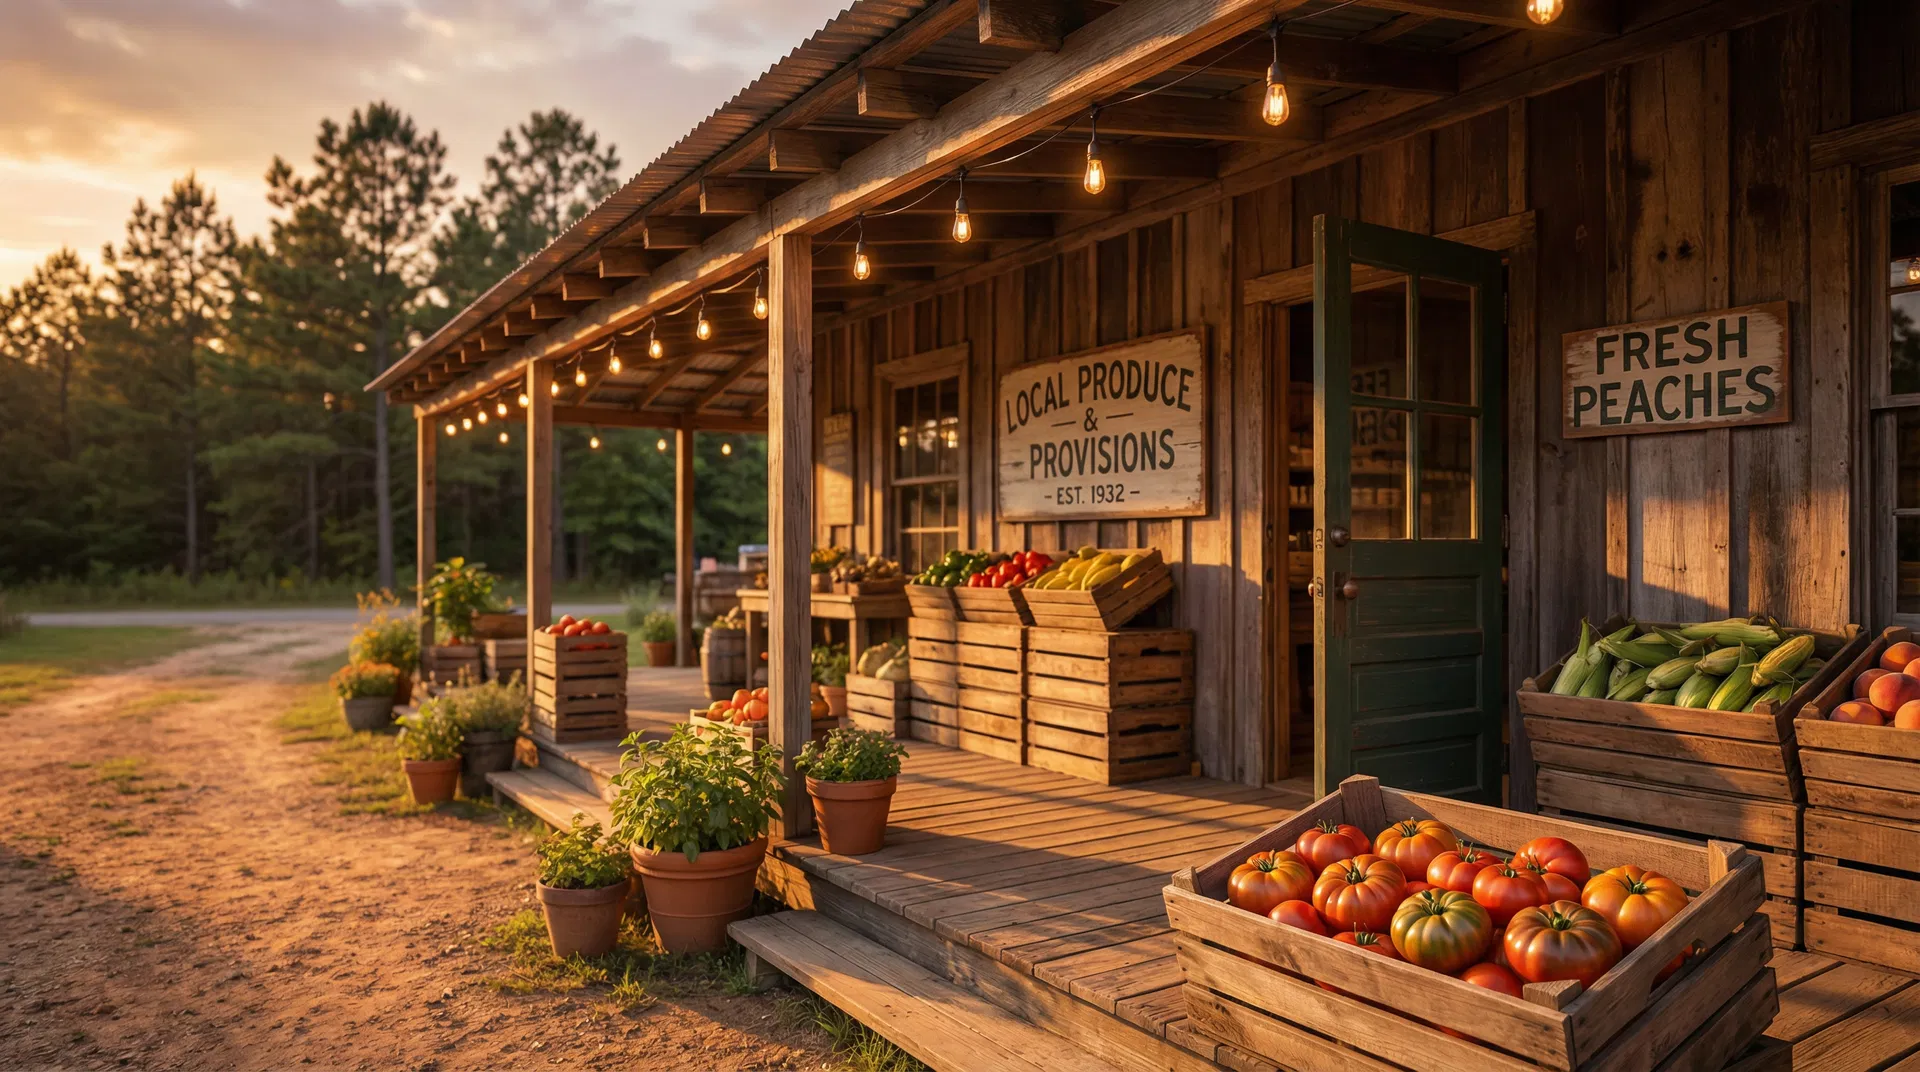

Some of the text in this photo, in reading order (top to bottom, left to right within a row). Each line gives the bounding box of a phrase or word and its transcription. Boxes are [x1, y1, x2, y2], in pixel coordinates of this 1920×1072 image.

[1596, 315, 1748, 375] FRESH
[1006, 359, 1195, 435] LOCAL PRODUCE
[1083, 407, 1099, 432] &
[1573, 365, 1775, 428] PEACHES
[1030, 428, 1176, 480] PROVISIONS
[1057, 483, 1125, 505] EST. 1932
